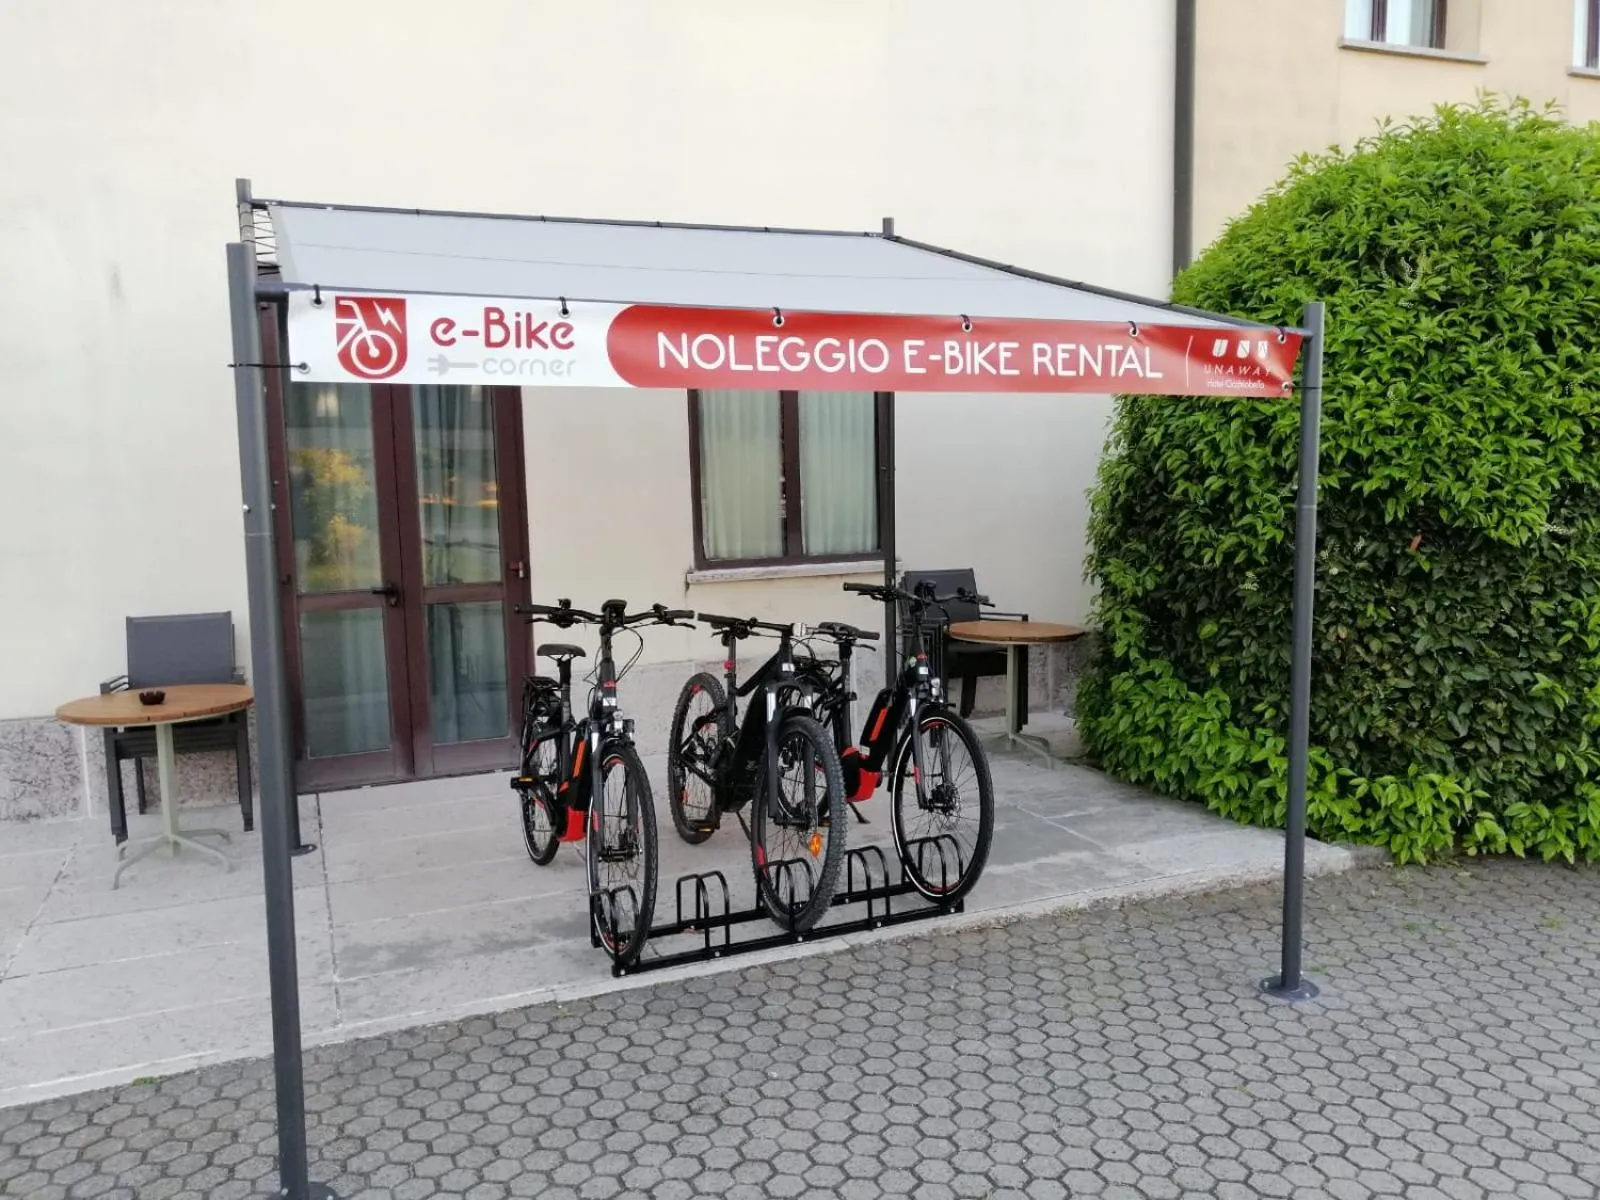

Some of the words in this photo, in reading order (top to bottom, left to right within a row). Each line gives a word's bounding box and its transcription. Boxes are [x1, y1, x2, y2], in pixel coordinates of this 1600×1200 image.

[429, 306, 576, 350] e-Bike
[482, 356, 576, 377] corner
[657, 331, 890, 374] NOLEGGIO
[904, 339, 1020, 377] E-BIKE
[1033, 342, 1164, 379] RENTAL
[1203, 363, 1271, 377] UNAWAY
